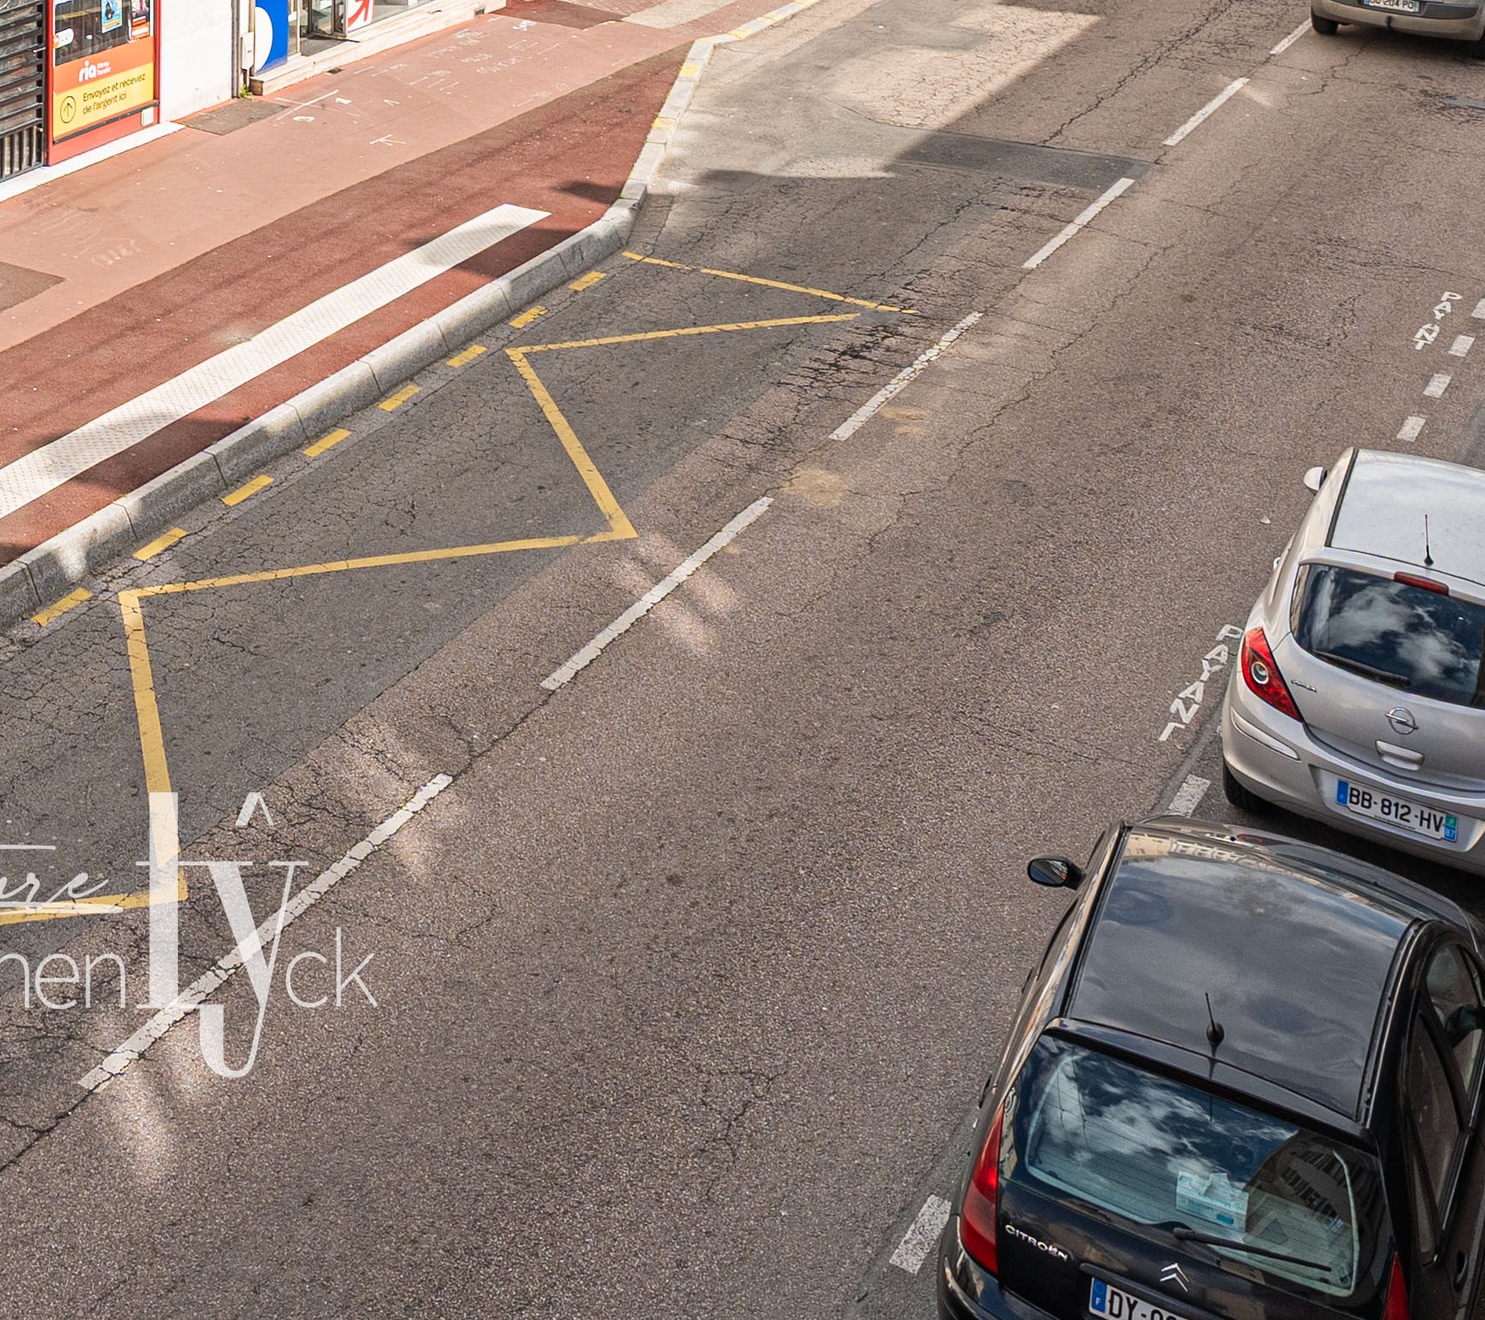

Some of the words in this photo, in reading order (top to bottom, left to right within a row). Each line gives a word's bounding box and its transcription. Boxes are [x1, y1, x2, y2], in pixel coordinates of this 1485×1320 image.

[78, 60, 97, 82] ria
[82, 85, 111, 103] Envoyez
[111, 82, 119, 93] et
[119, 73, 147, 89] recevez
[82, 103, 92, 115] de
[92, 94, 119, 113] l'argent
[118, 91, 128, 104] ici
[1349, 787, 1444, 833] BB-812-HV
[1005, 1223, 1069, 1261] CITROËN
